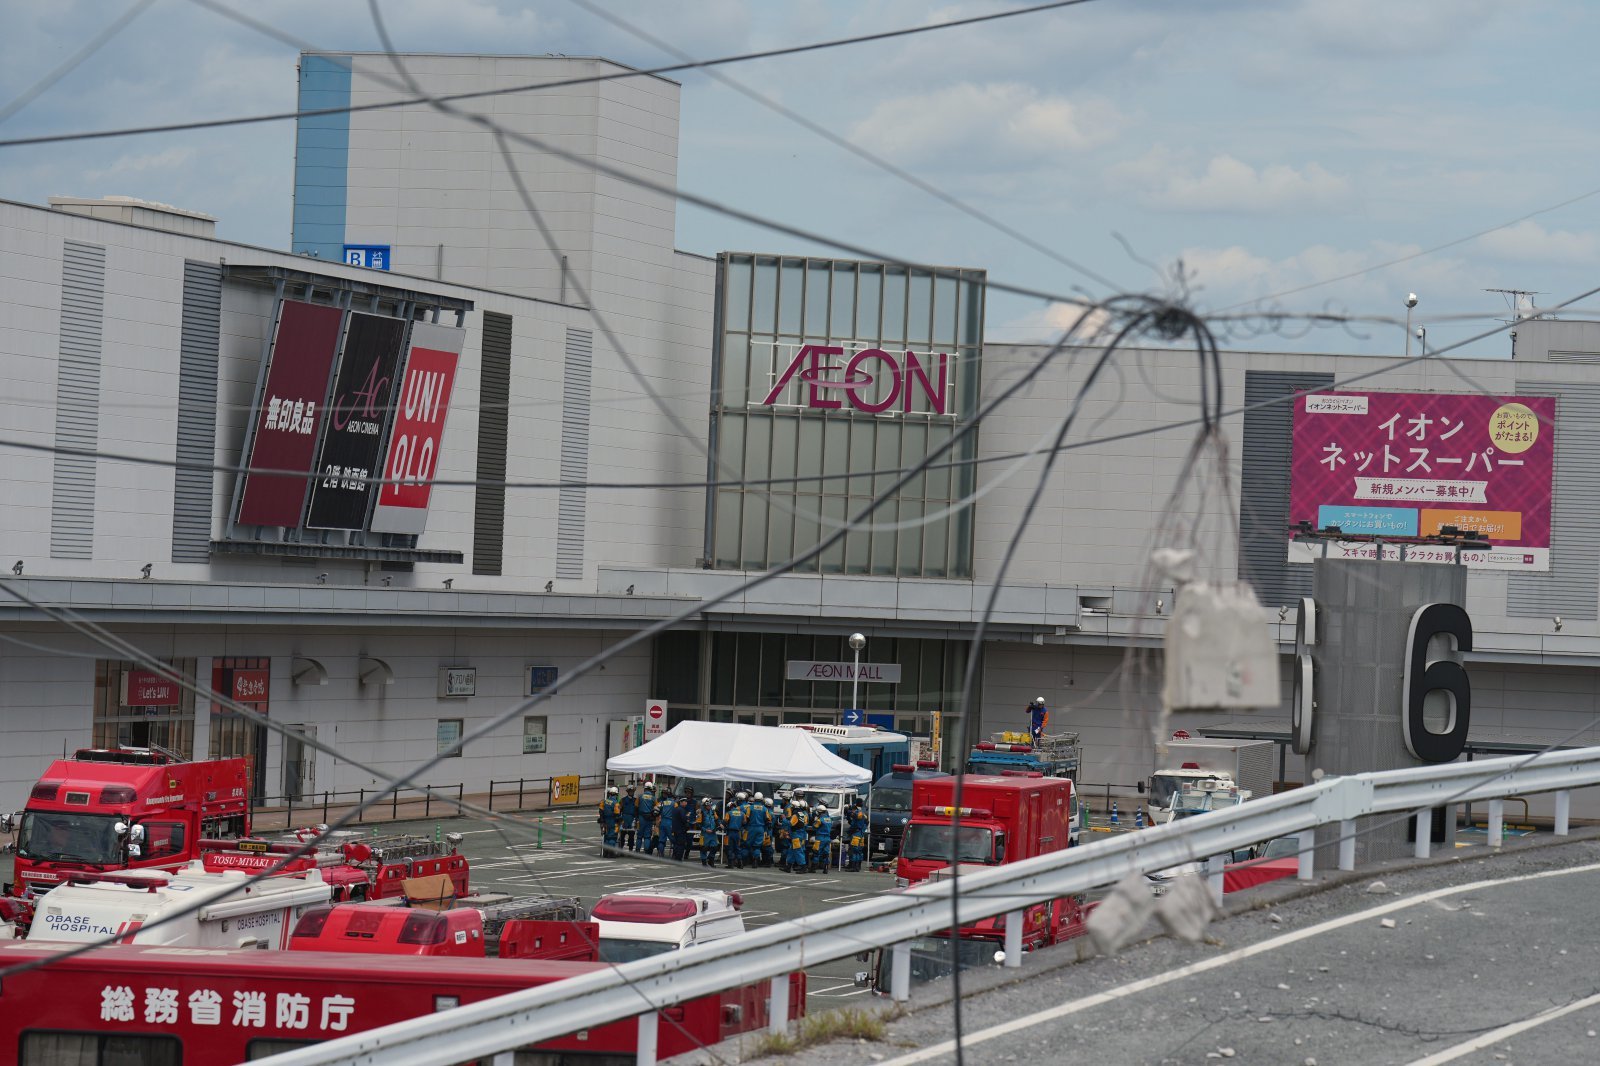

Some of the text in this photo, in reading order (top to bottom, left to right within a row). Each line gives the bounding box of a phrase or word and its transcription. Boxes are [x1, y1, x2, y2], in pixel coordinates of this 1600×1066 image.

[350, 252, 361, 266] B
[405, 369, 446, 424] UNI
[265, 394, 316, 435] 無印良品
[1308, 403, 1367, 411] イオンネットスーパー
[1496, 412, 1533, 420] お買いもので
[361, 421, 380, 436] CINEMA
[1377, 412, 1465, 441] イオン
[1497, 420, 1530, 431] ポイント
[1495, 431, 1533, 442] がたまる!
[391, 433, 434, 496] QLO
[1319, 442, 1525, 474] ネットスーパー
[1370, 482, 1475, 498] 新規メンバー募集中!
[846, 665, 883, 680] MALL
[1403, 603, 1473, 762] 6
[45, 915, 91, 925] OBASE
[237, 912, 281, 931] OBASE HOSPITAL
[51, 923, 116, 935] HOSPITAL
[100, 985, 356, 1031] 総務省消防庁
